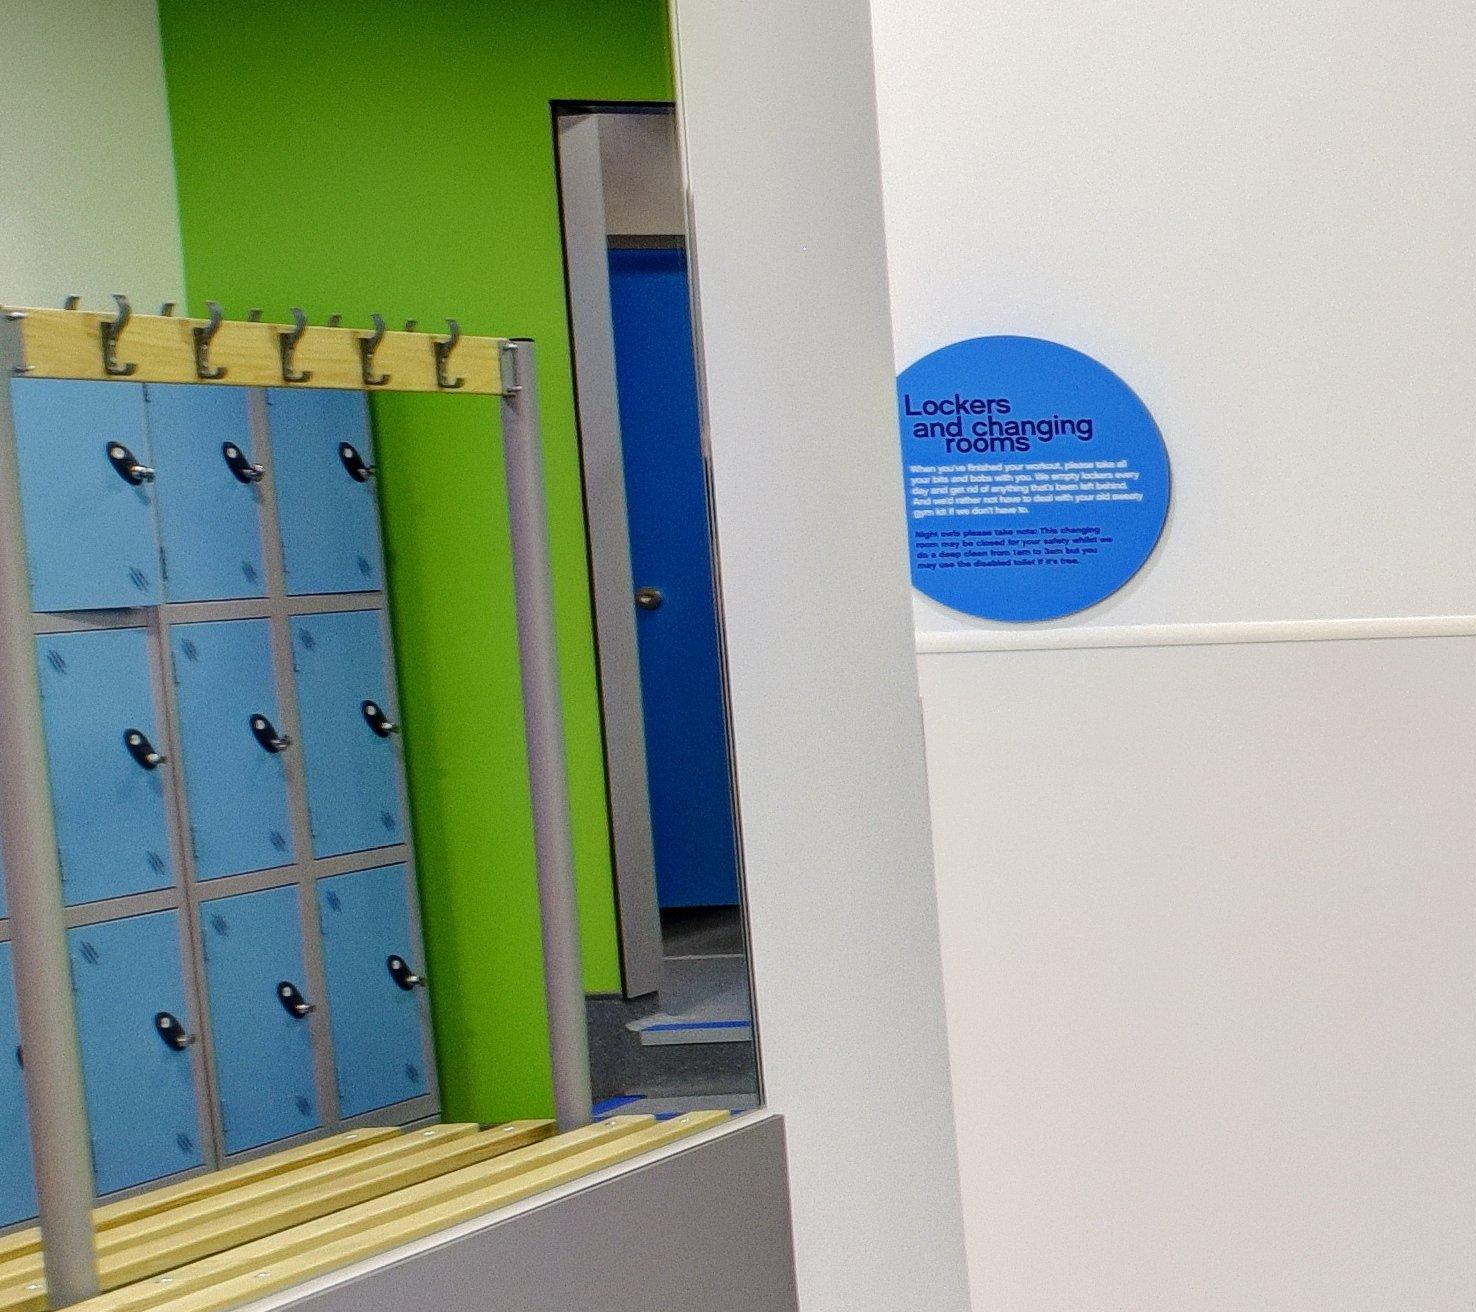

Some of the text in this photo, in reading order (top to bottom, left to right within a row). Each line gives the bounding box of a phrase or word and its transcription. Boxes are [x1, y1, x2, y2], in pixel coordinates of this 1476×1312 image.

[904, 393, 1011, 416] Lockers
[913, 415, 1093, 442] and changing
[945, 437, 1031, 453] rooms
